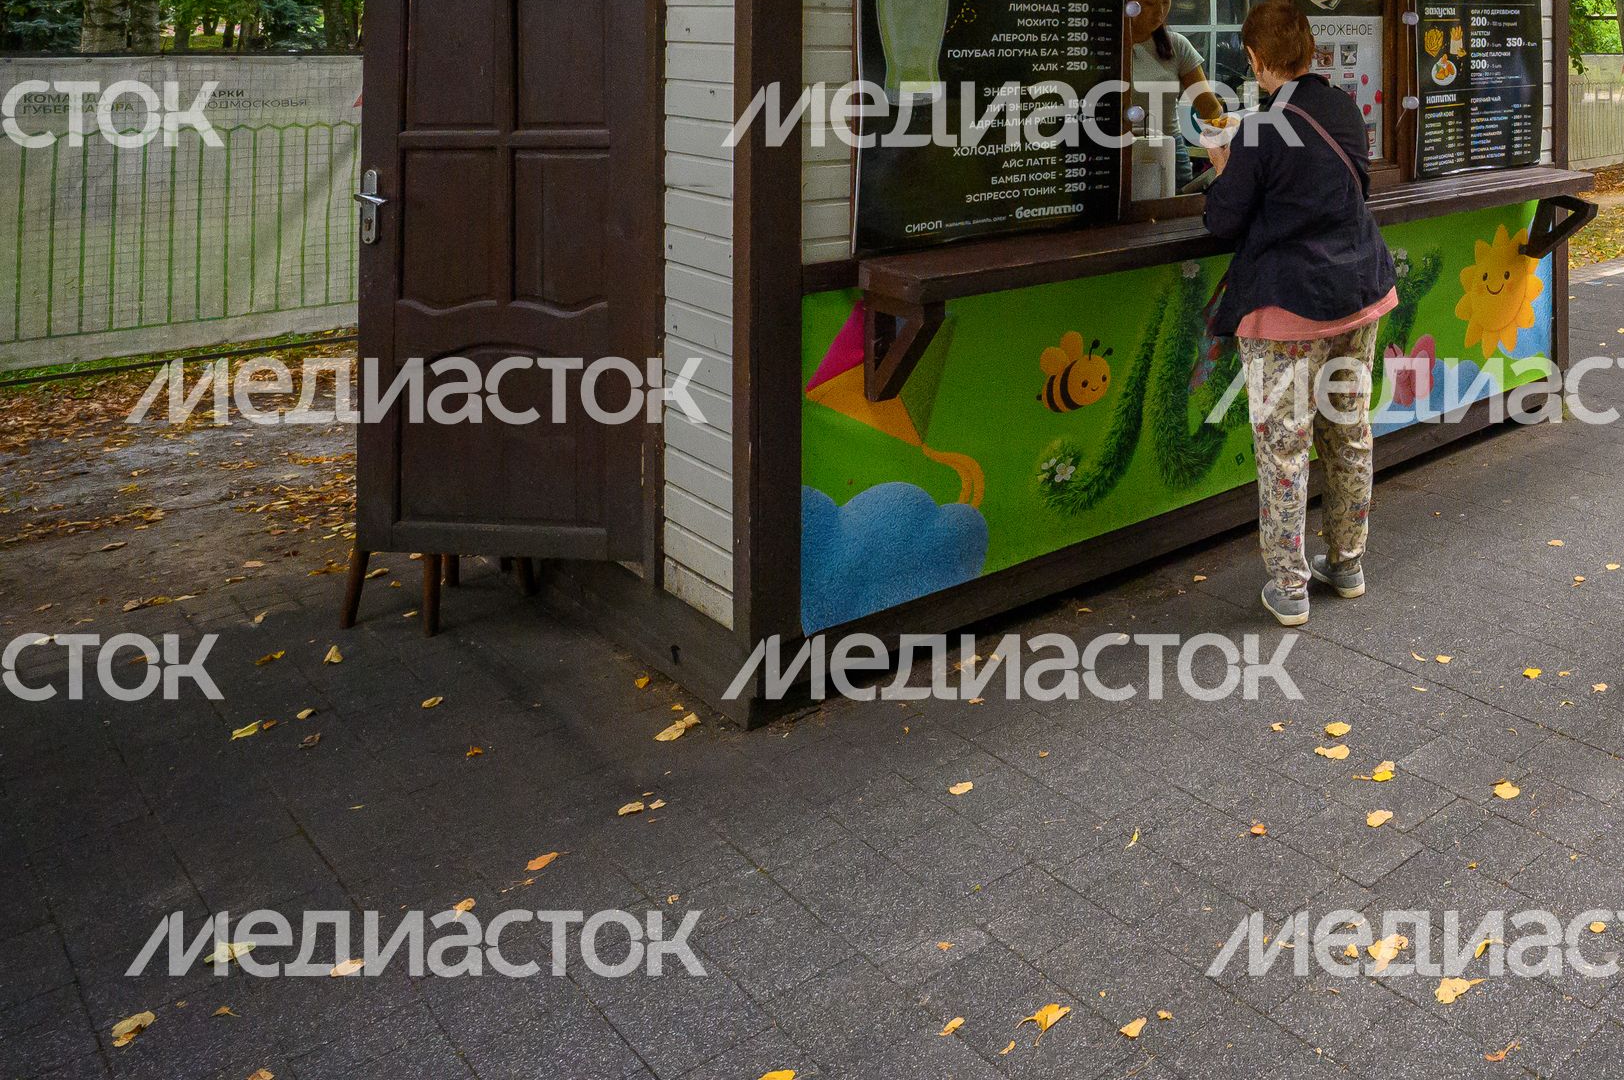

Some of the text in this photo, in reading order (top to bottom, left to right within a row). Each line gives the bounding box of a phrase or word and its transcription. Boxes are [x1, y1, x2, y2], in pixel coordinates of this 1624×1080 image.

[1009, 3, 1089, 13] ЛИМОНАД 250
[1425, 7, 1456, 18] закуски
[1017, 18, 1089, 27] МОХИТО 250
[1471, 17, 1487, 26] 200
[1311, 24, 1373, 36] ОРОЖЕНОЕ
[992, 32, 1088, 42] АПЕРОЛЬ Б/А 250
[1471, 37, 1522, 47] 280 350
[948, 47, 1088, 58] ГОЛУБАЯ ЛОГУНА Б/А 250
[1032, 62, 1087, 71] ХАЛК 250
[1471, 60, 1487, 69] 300
[201, 90, 244, 98] ПАРКИ
[984, 85, 1057, 97] ЭНЕРГЕТИКИ
[22, 103, 135, 113] ГУБЕРНАТОРА
[201, 100, 308, 110] ПОДМОСКОВЬЯ
[986, 102, 1007, 113] ЛИТ
[1009, 101, 1057, 111] ЭНЕРДЖИ
[969, 118, 1032, 129] АДРЕНАЛИН
[1034, 116, 1056, 125] РАШ
[953, 141, 1057, 157] ХОЛОДНЫЙ КОФЕ
[1002, 153, 1086, 169] АЙС ЛАТТЕ 250
[991, 168, 1086, 185] БАМБЛ КОФЕ 250
[966, 182, 1086, 203] ЭСПРЕССО ТОНИК 250
[905, 221, 942, 233] СИРОП
[1015, 203, 1084, 219] бесплатно
